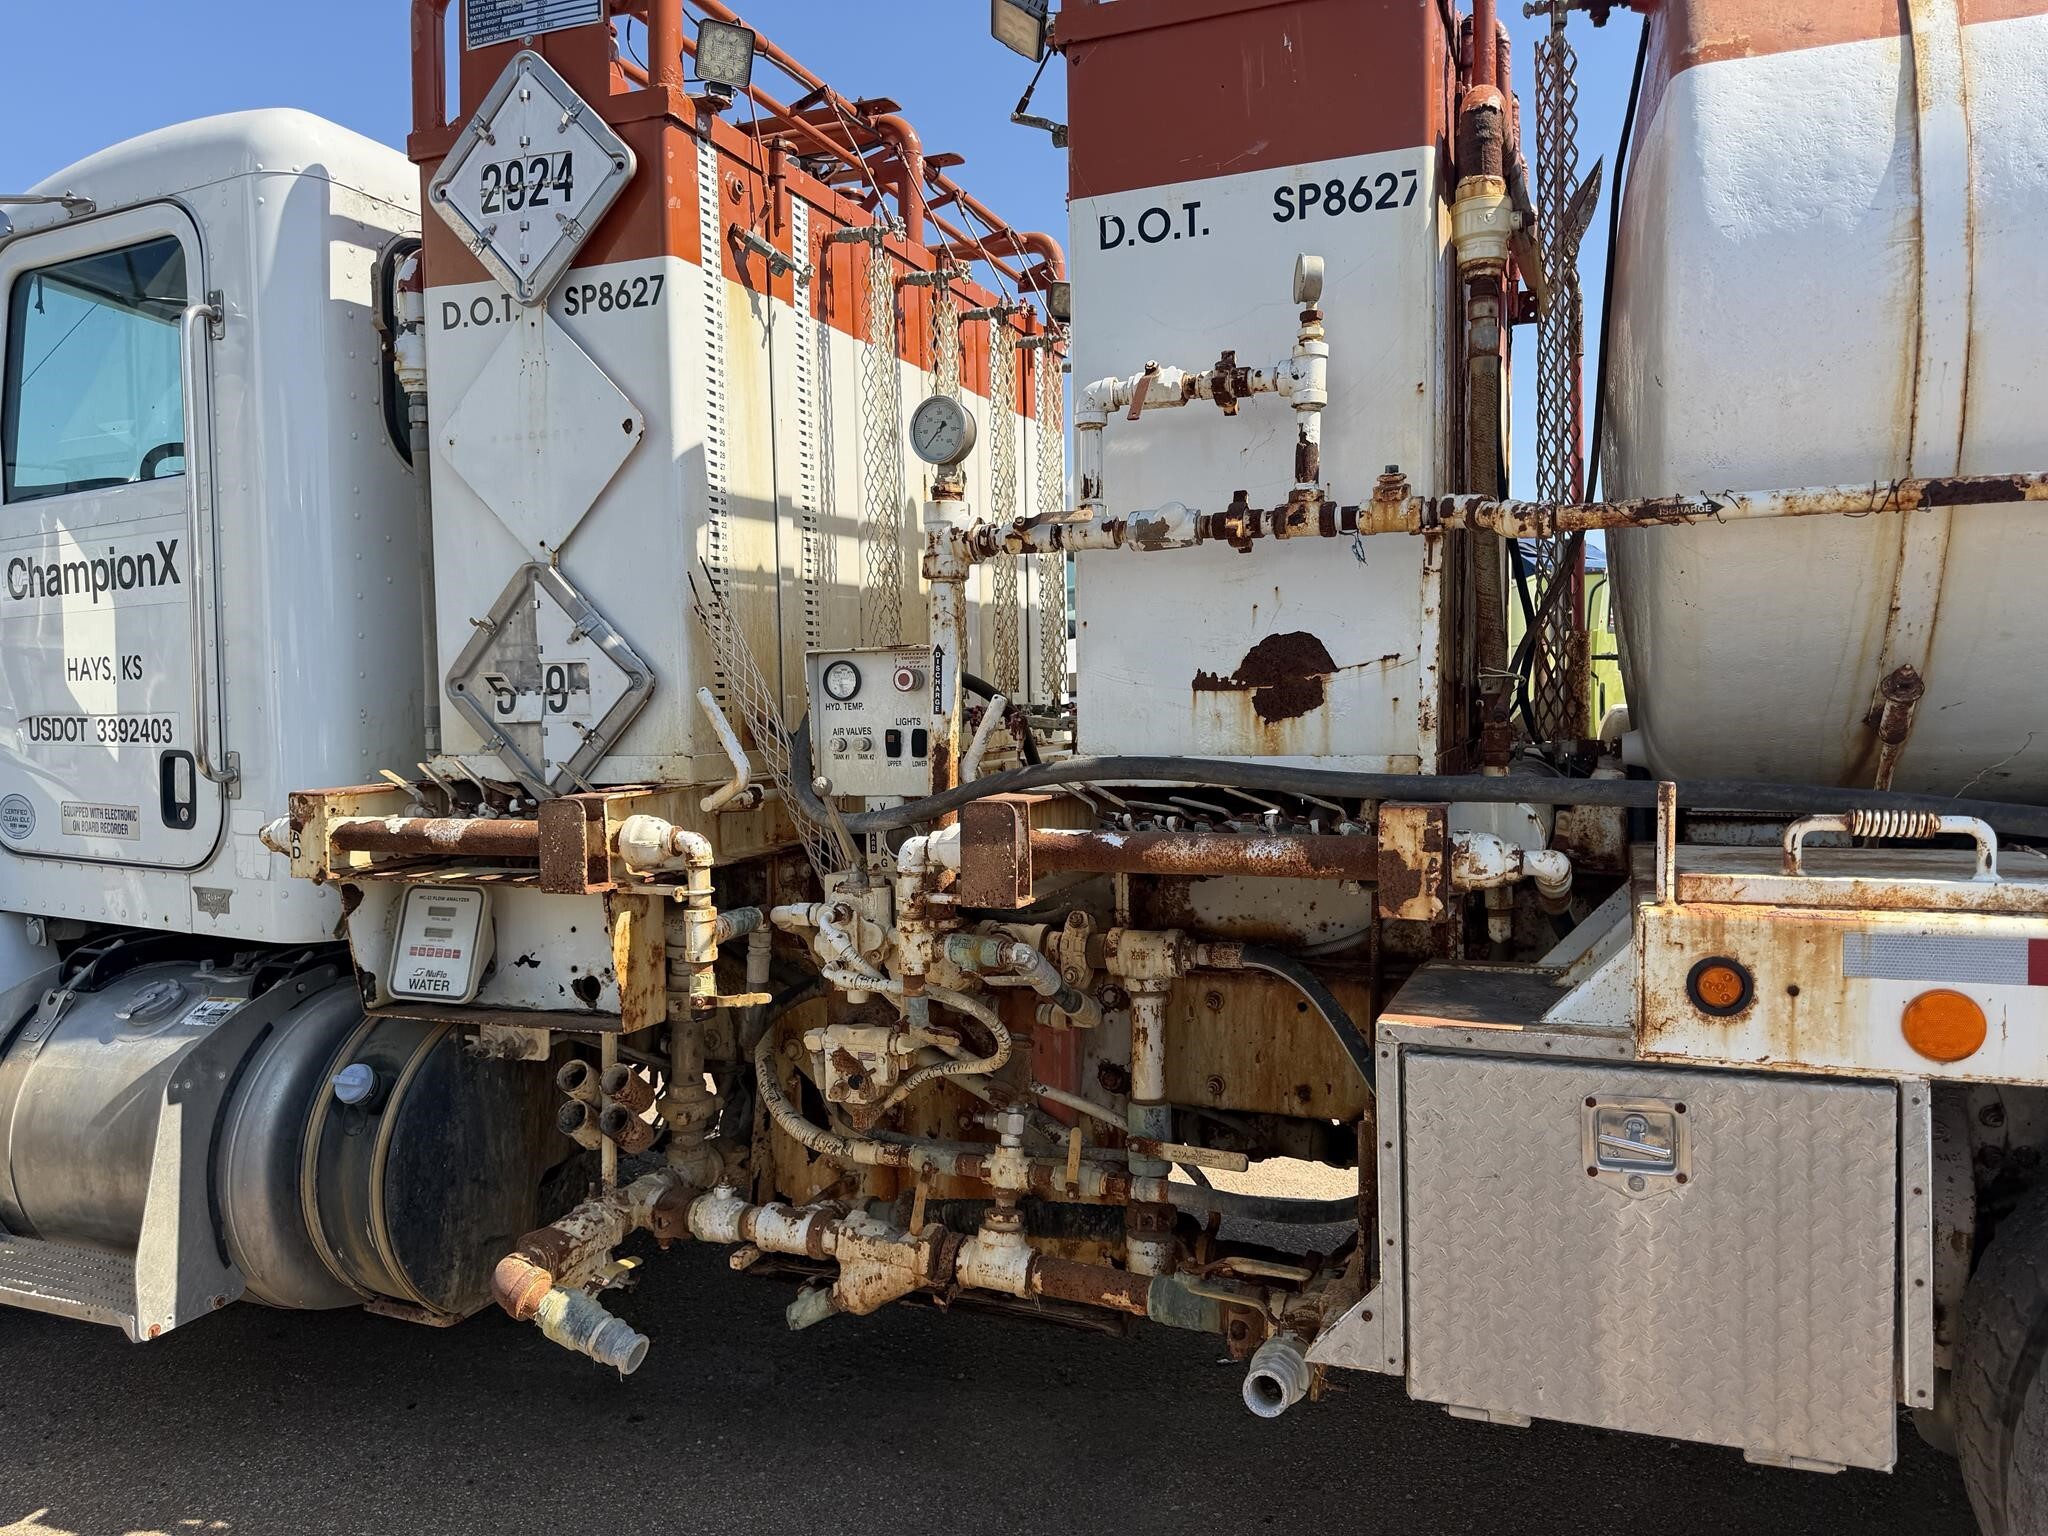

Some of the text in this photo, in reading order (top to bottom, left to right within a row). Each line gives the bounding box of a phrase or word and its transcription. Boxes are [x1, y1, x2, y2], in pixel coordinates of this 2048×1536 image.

[481, 152, 574, 214] 2924
[1100, 169, 1417, 250] D.O.T. SP8627
[564, 274, 664, 316] SP8627
[1659, 504, 1712, 516] ISCHARGE
[7, 539, 181, 603] ChampionX
[68, 655, 143, 684] HAYS, KS
[485, 665, 568, 714] 5 9
[29, 717, 173, 744] USDOT 3392403
[846, 727, 872, 735] VALVES
[895, 718, 921, 726] LIGHTS
[64, 806, 137, 822] EQUIPPED WITH ELECTRONIC
[73, 821, 129, 835] ON BOARD RECORDER
[409, 978, 450, 991] WATER
[426, 970, 447, 978] NuFlo
